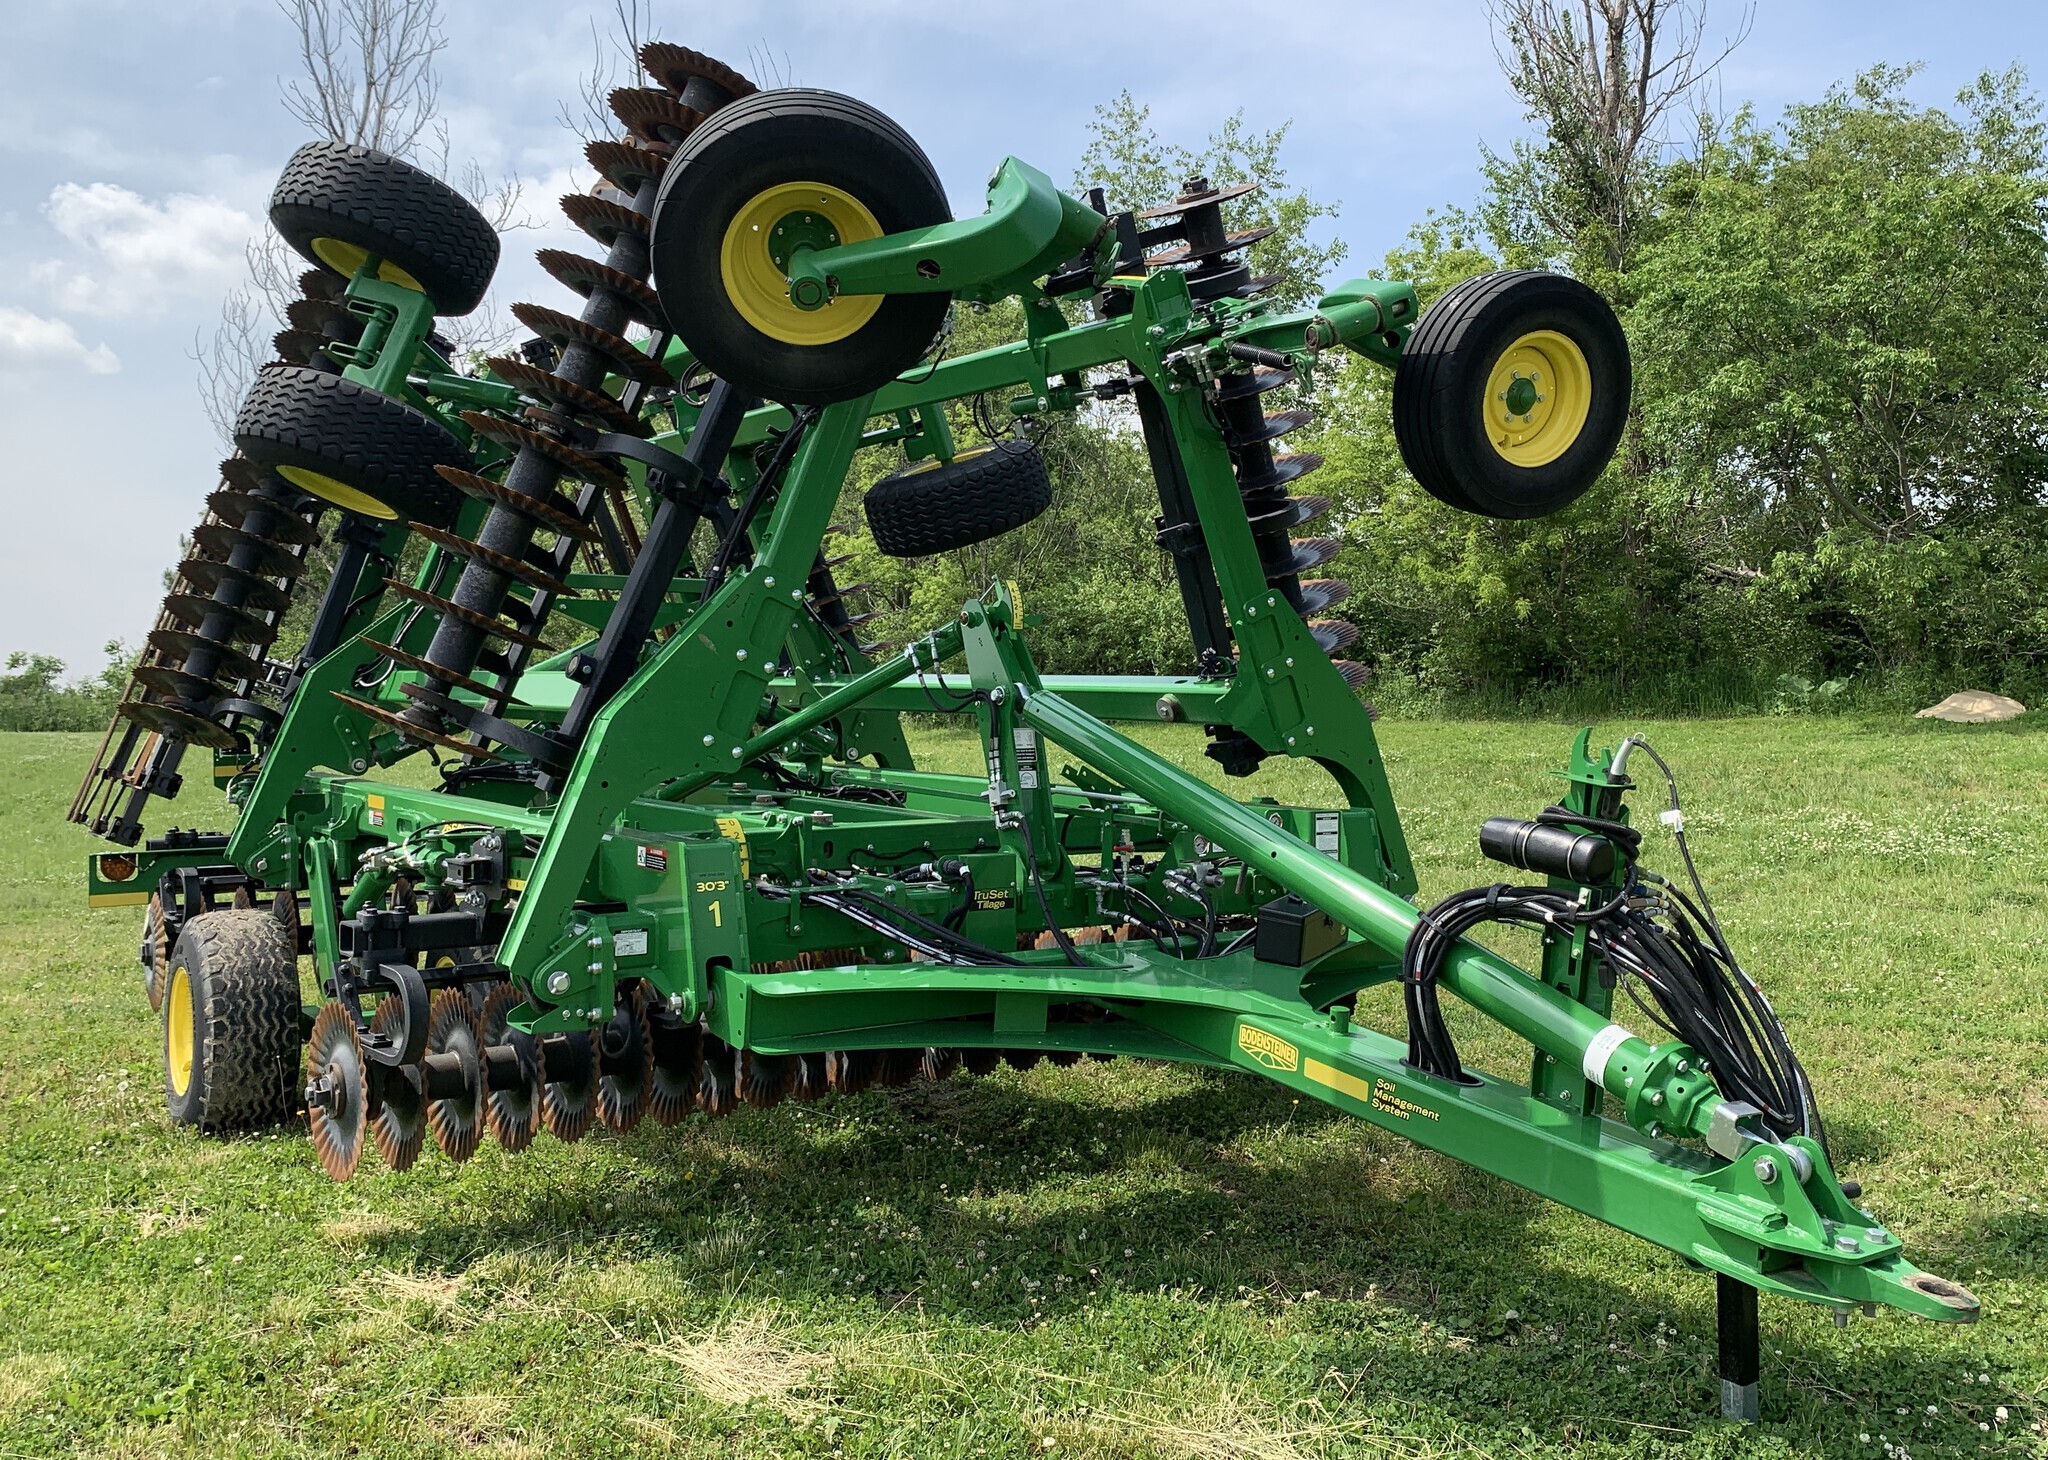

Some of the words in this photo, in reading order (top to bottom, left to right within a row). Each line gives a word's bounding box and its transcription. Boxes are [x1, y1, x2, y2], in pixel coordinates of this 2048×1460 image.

[728, 819, 736, 827] 0
[733, 831, 741, 840] 2
[974, 889, 1009, 900] TruSet
[708, 900, 722, 927] 1
[1240, 1027, 1297, 1065] BODENSTEINER
[1376, 1078, 1396, 1092] Soil
[1371, 1098, 1410, 1120] System
[1373, 1087, 1440, 1121] Management
